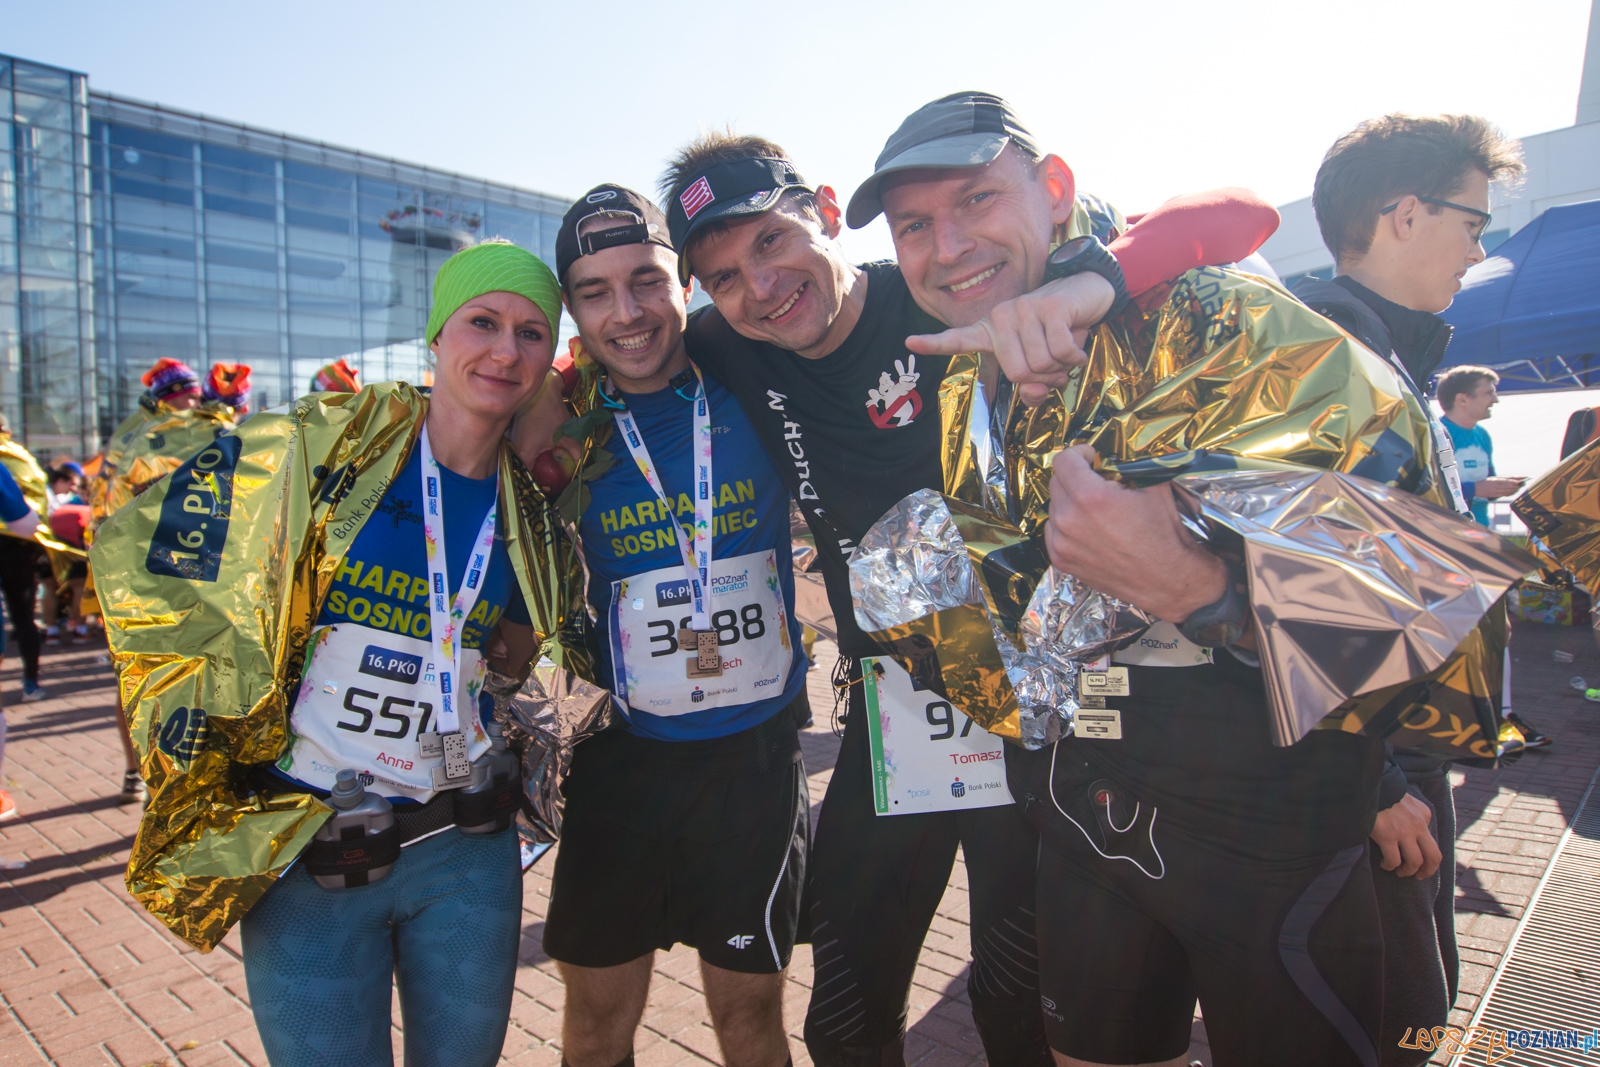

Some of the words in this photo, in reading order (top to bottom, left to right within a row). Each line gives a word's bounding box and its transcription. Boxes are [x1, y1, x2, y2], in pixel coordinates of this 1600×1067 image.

[183, 449, 223, 515] PKO
[333, 509, 364, 540] Bank
[361, 475, 392, 510] Polski
[601, 479, 755, 534] HARPAAN
[611, 509, 758, 557] SOSNOIEC
[334, 557, 505, 628] HARPAN
[660, 588, 677, 601] 16.
[712, 581, 749, 594] maraton
[367, 654, 385, 669] 16.
[388, 658, 417, 676] PKO
[336, 687, 438, 742] 551
[376, 752, 414, 770] Anna
[949, 750, 1003, 764] Tomasz
[726, 934, 755, 949] 4F
